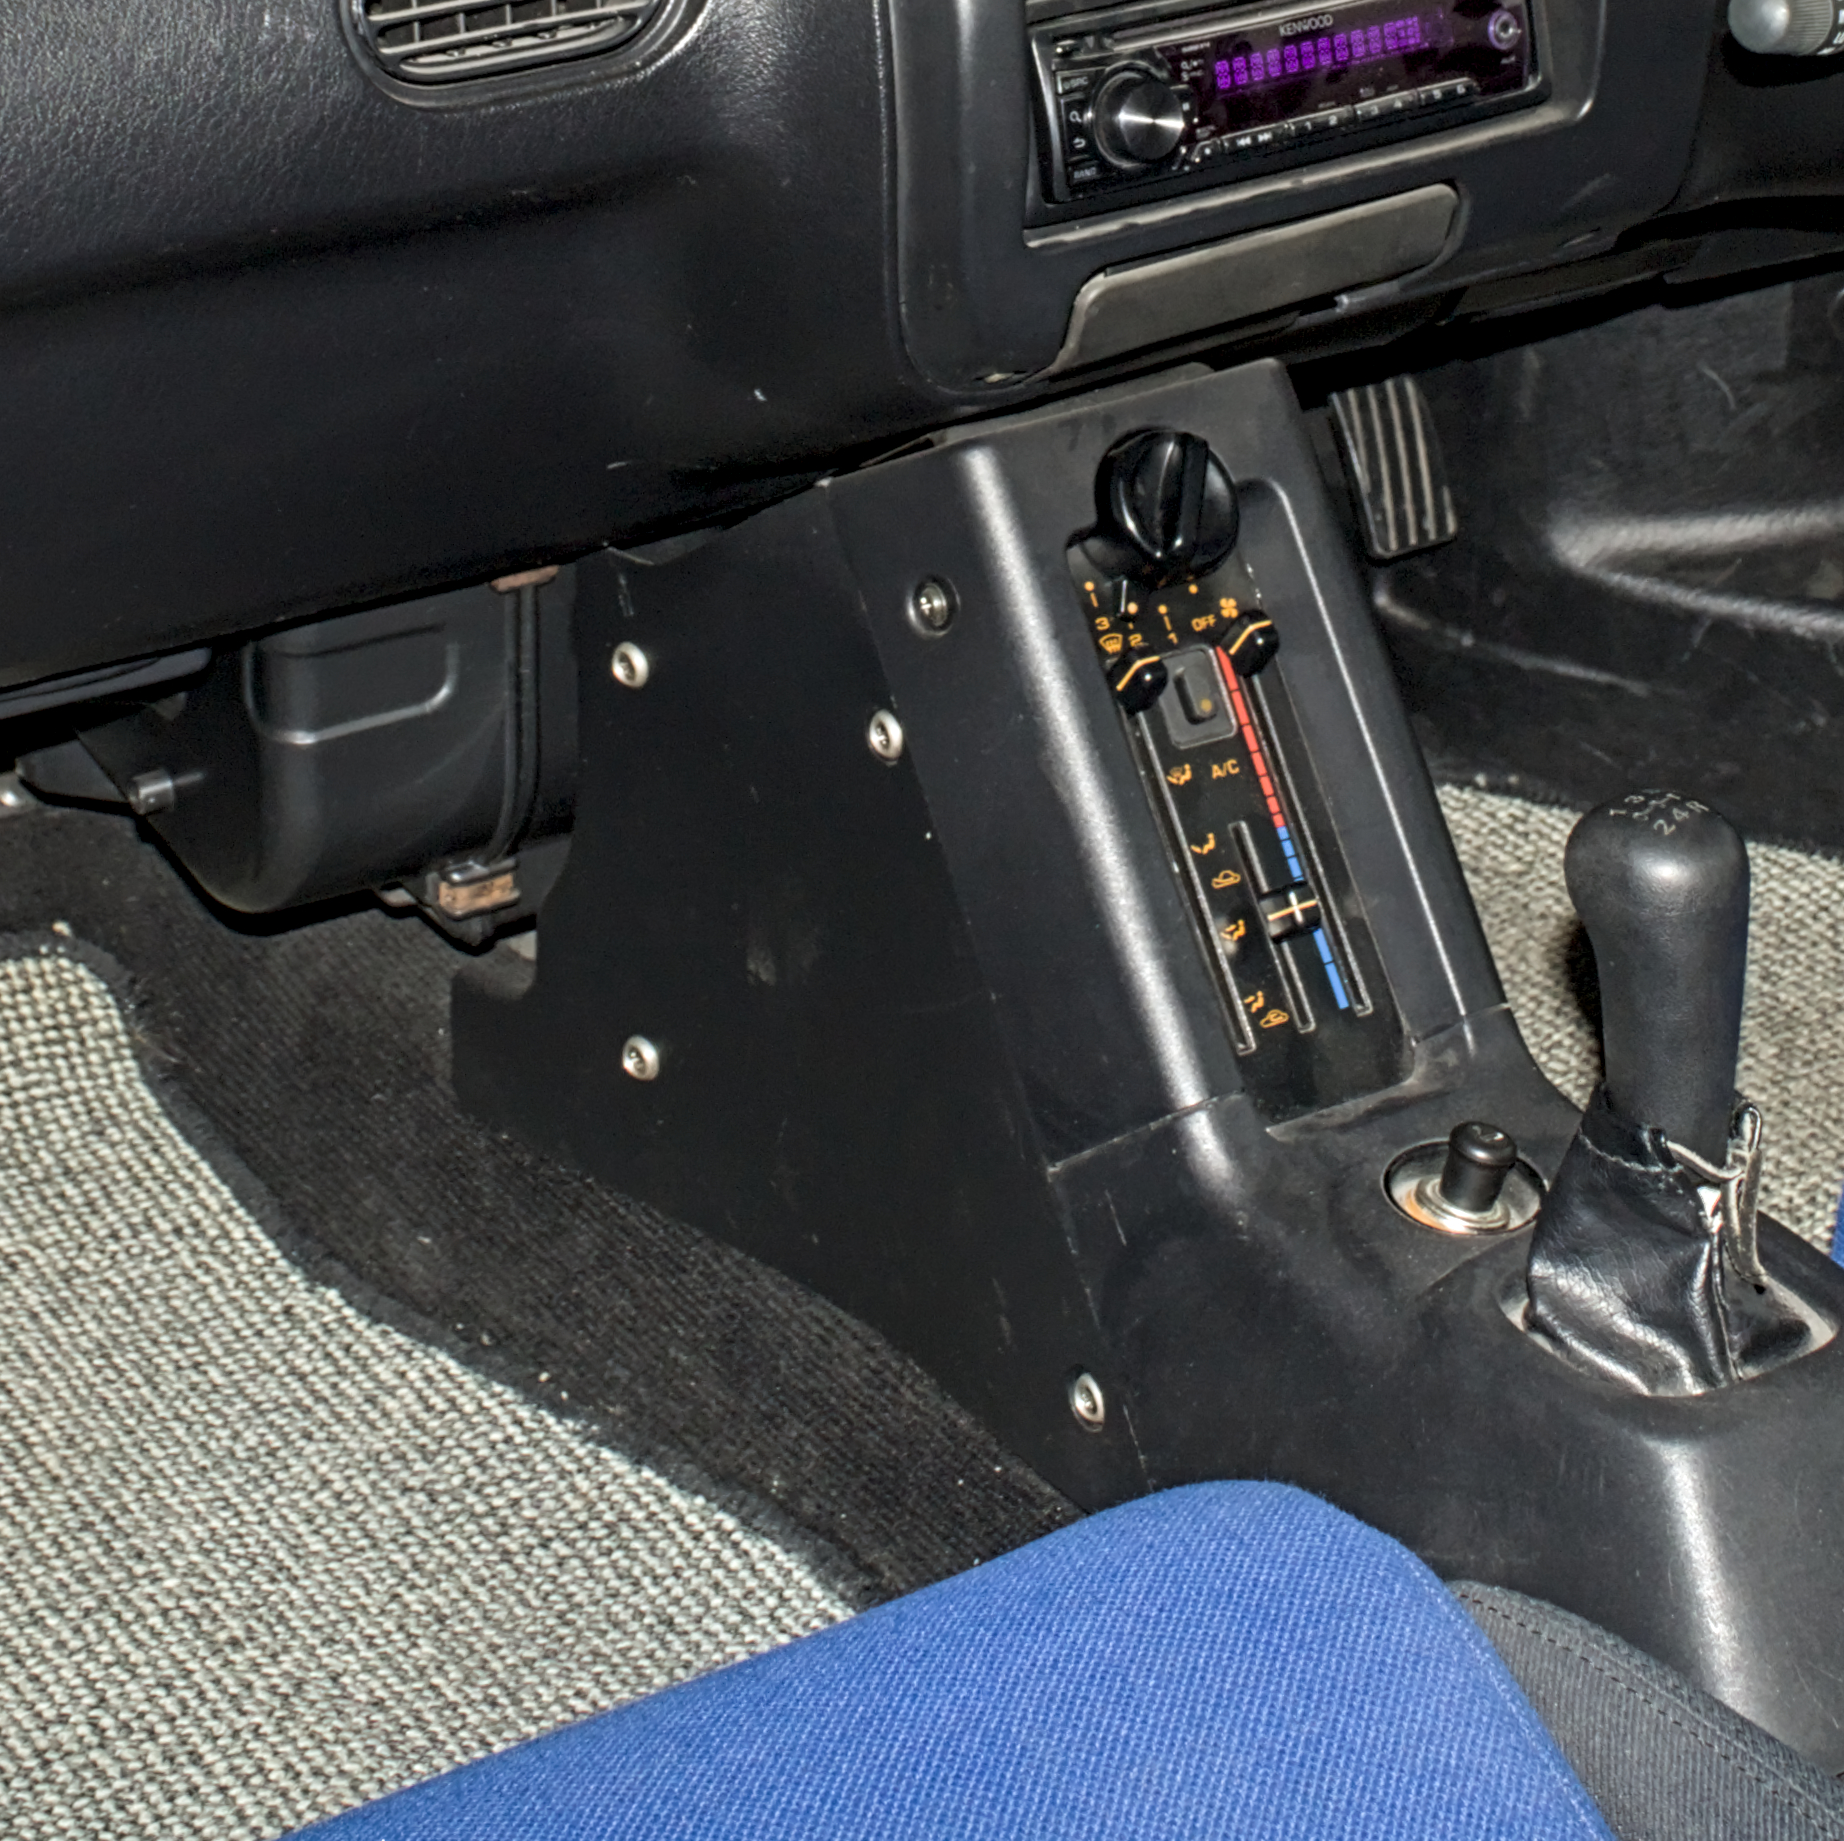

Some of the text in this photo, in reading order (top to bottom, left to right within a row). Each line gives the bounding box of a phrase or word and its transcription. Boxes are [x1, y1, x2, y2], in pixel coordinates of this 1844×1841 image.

[1279, 13, 1334, 37] KENWOOD
[1095, 616, 1179, 648] 3 2 1
[1191, 614, 1217, 633] OFF
[1211, 759, 1240, 780] A/C
[1653, 819, 1677, 836] 2
[1672, 807, 1689, 822] 4
